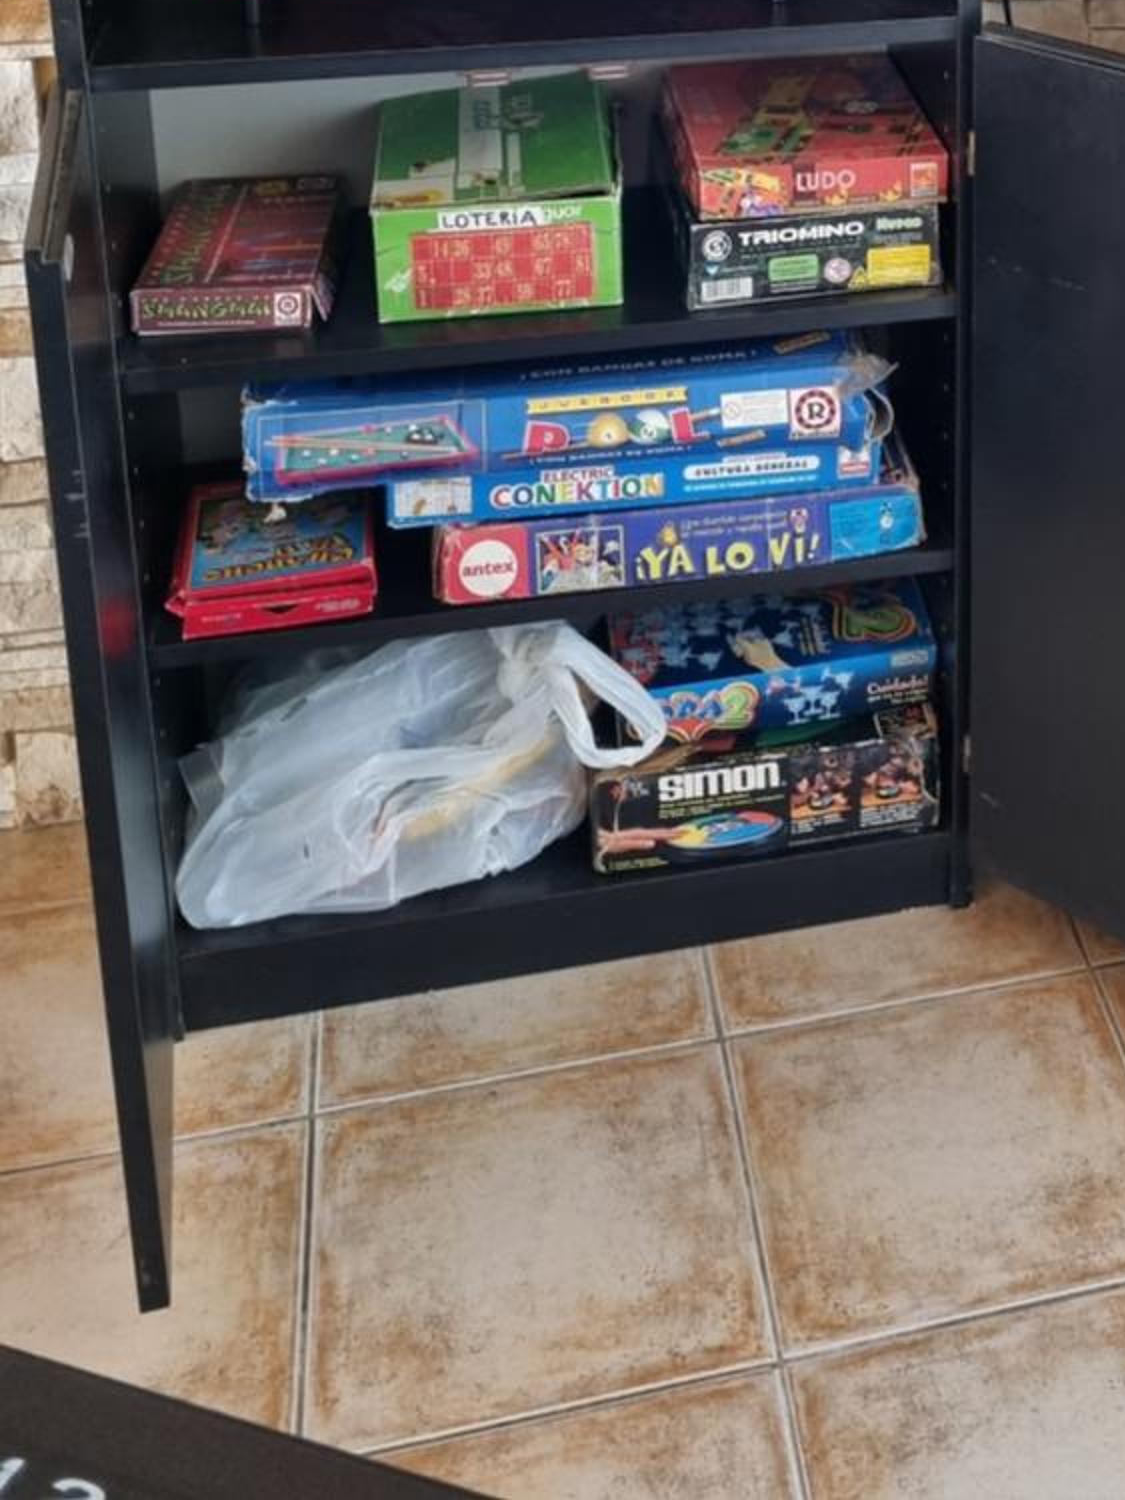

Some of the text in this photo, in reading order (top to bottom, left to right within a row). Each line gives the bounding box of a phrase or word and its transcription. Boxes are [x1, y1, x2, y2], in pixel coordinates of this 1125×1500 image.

[796, 170, 855, 192] LUDO
[738, 222, 864, 247] TRIOMINO
[543, 467, 613, 483] ELECTRIC
[492, 474, 663, 508] CONEKTION
[462, 564, 515, 577] antex
[636, 546, 694, 580] ¡YA
[706, 543, 754, 574] LO
